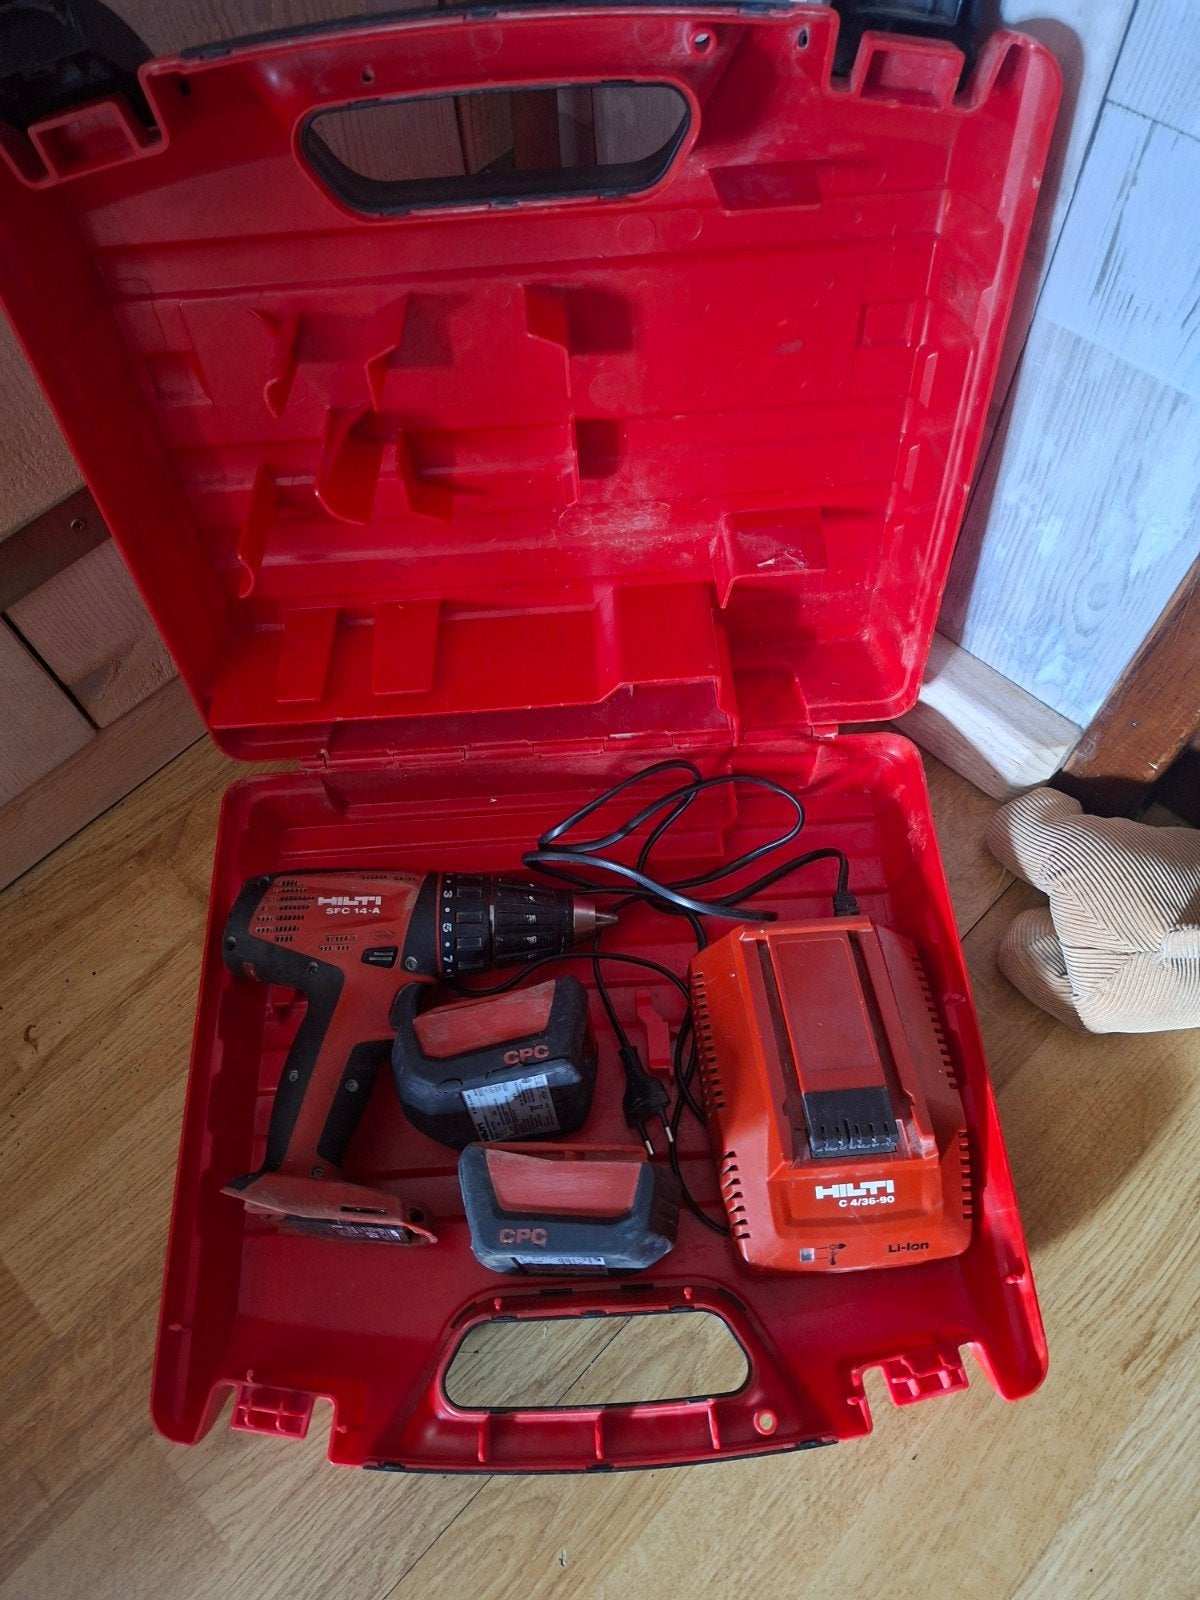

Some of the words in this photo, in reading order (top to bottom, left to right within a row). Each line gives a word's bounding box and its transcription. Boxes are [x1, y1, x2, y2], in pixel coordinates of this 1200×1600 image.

[317, 896, 382, 906] HILTI
[326, 907, 350, 915] SFC
[503, 1045, 550, 1066] CPC
[815, 1179, 895, 1199] HILTI
[838, 1199, 848, 1208] C
[849, 1195, 895, 1207] 4/36-90
[499, 1228, 548, 1246] CPC
[888, 1242, 929, 1253] Li-Ion
